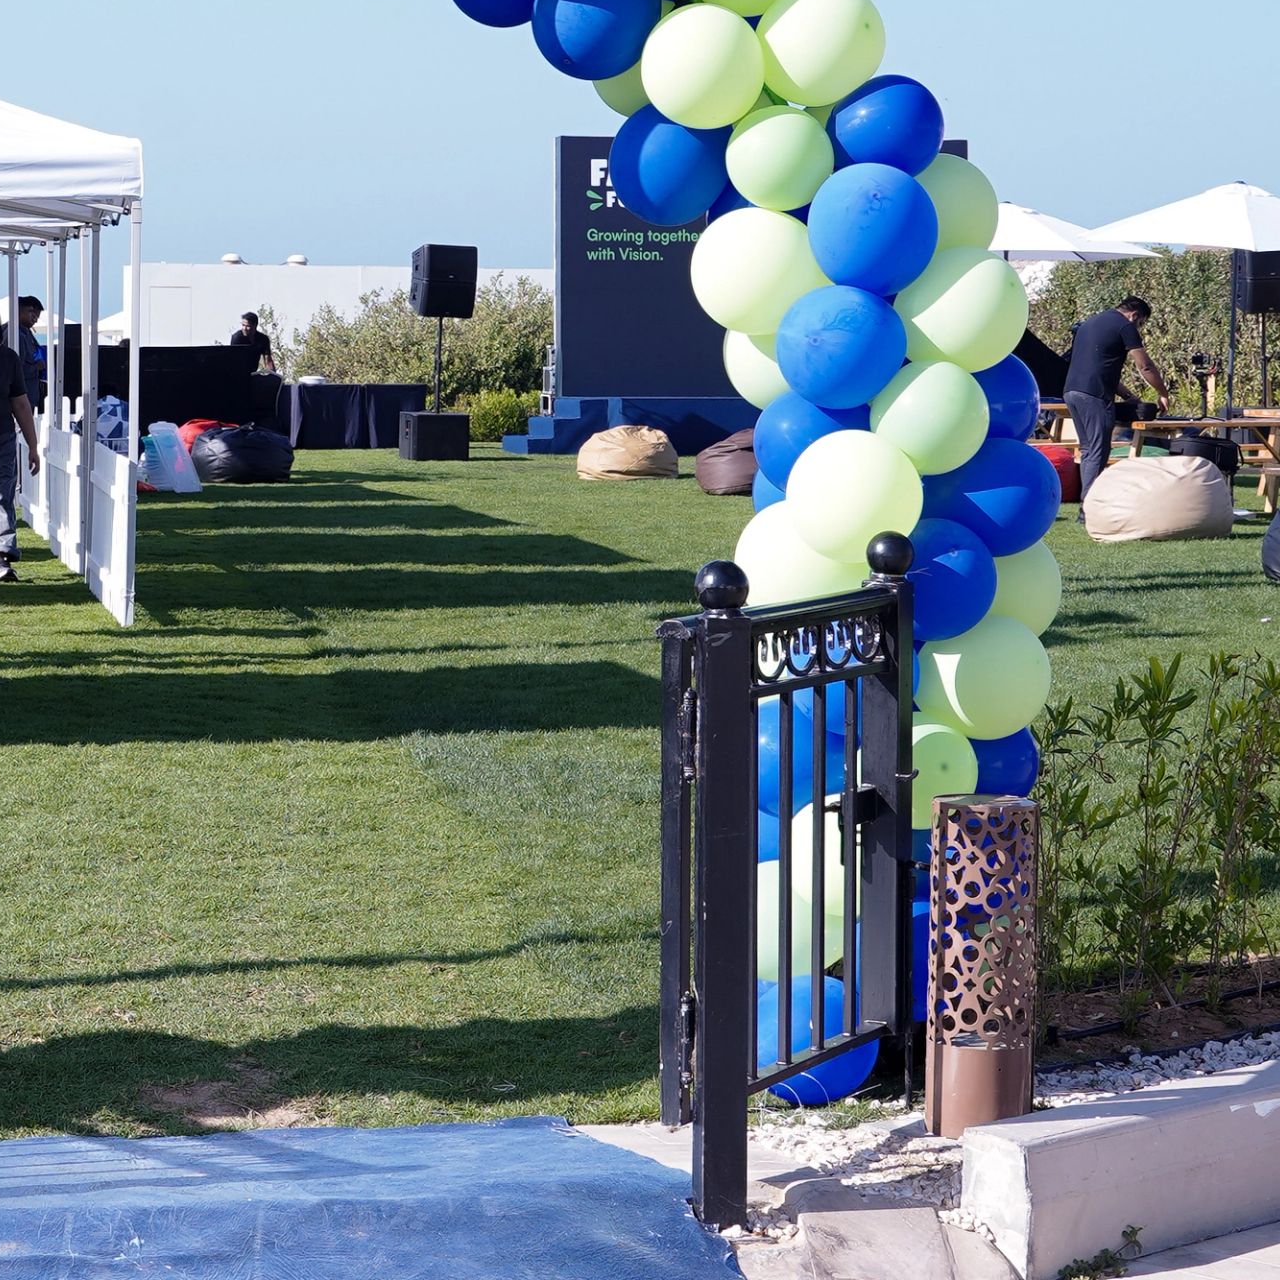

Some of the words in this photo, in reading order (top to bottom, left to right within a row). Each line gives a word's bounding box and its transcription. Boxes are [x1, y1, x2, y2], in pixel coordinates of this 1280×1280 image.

[586, 228, 644, 246] Growing
[586, 247, 616, 261] with
[618, 247, 664, 261] Vision.
